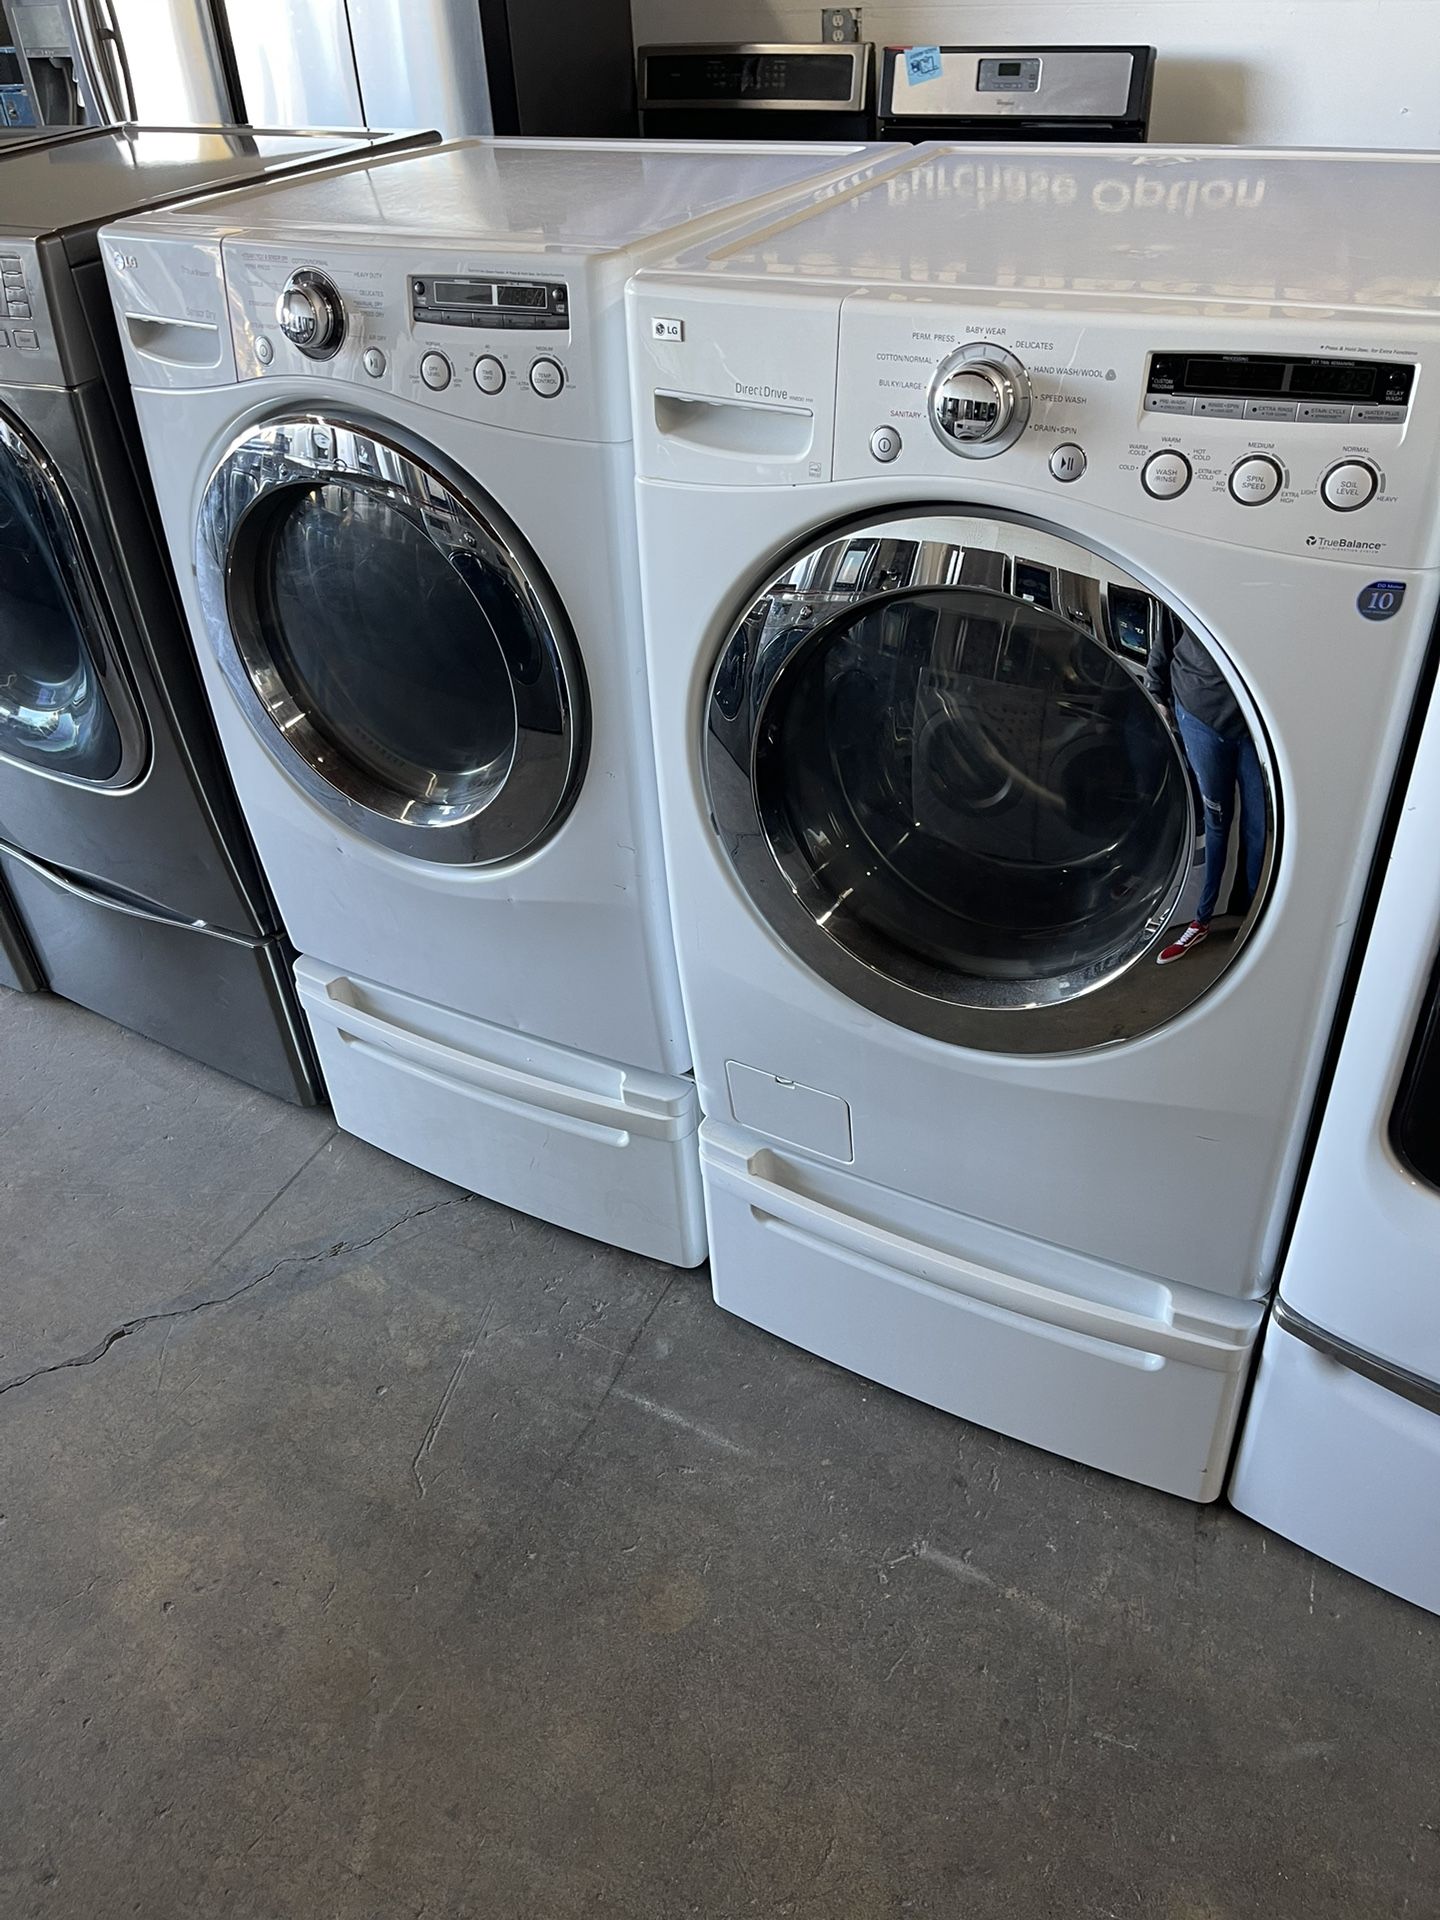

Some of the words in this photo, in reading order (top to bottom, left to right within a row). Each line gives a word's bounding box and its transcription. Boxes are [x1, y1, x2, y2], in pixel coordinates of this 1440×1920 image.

[667, 327, 678, 335] LG
[966, 326, 985, 335] BABY
[985, 327, 1006, 336] WEAR
[935, 333, 955, 343] PRESS
[1015, 340, 1054, 350] DELICATES
[876, 353, 932, 364] COTTON/NORMAL
[1033, 366, 1055, 375] HAND
[1056, 367, 1104, 378] WASH/WOOL
[1040, 394, 1064, 403] SPEED
[1065, 395, 1087, 404] WASH
[890, 410, 922, 419] SANITARY
[1155, 468, 1178, 476] WASH
[1246, 475, 1265, 483] SPIN
[1241, 482, 1266, 491] SPEED
[1336, 488, 1359, 496] LEVEL
[1367, 592, 1394, 610] 10
